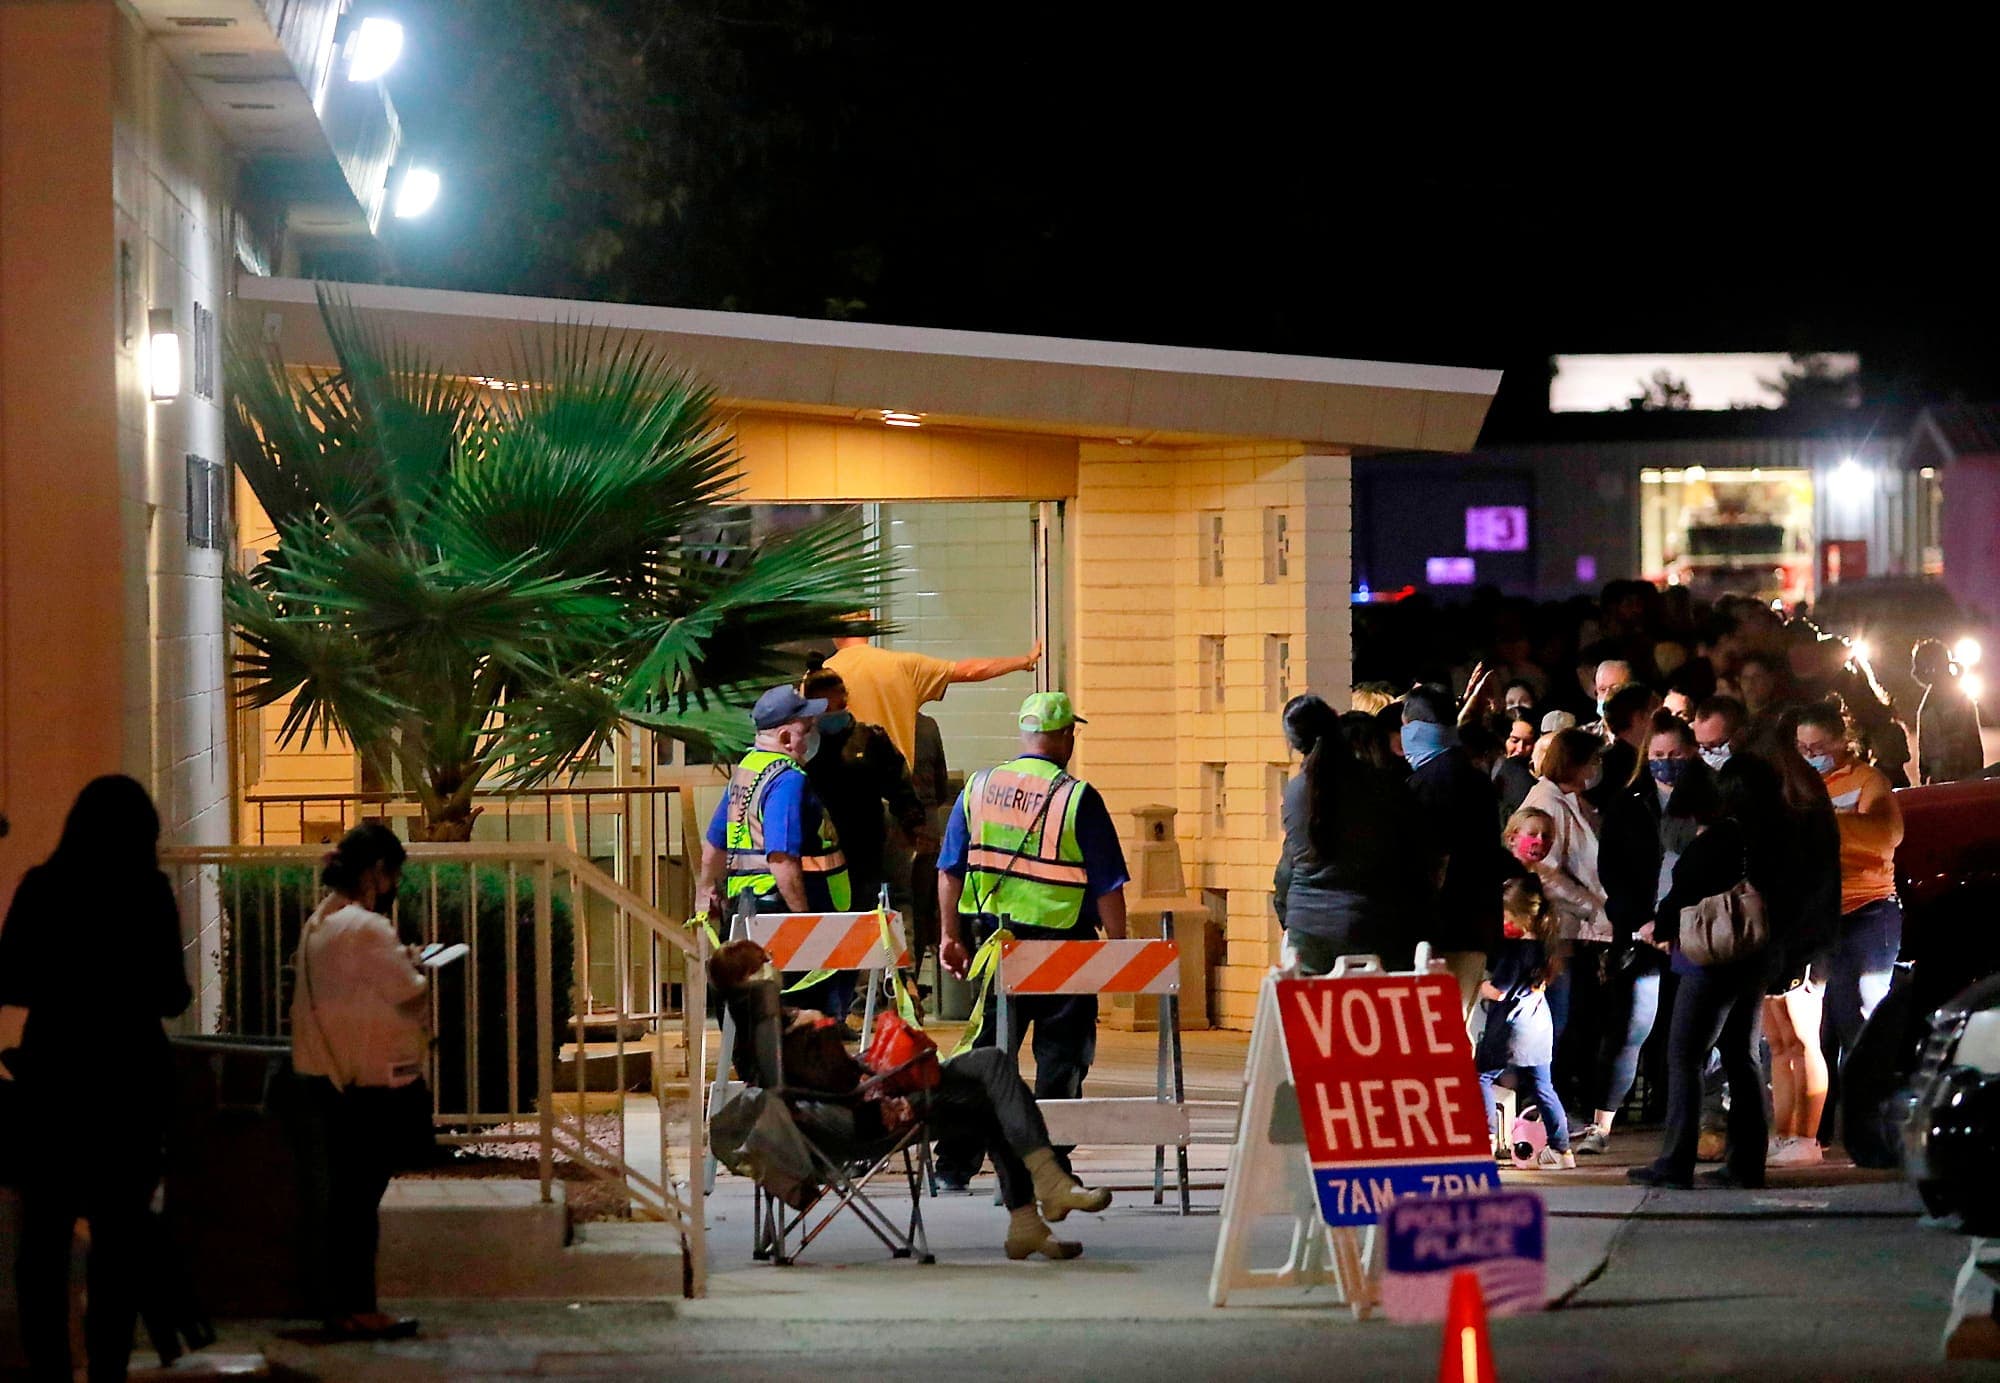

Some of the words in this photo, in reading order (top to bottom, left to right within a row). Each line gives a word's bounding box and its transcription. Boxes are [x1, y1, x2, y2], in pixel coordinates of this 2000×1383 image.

[986, 784, 1043, 814] SHERIFF
[1295, 986, 1454, 1058] VOTE
[1315, 1077, 1472, 1151] HERE
[1328, 1177, 1396, 1216] 7AM
